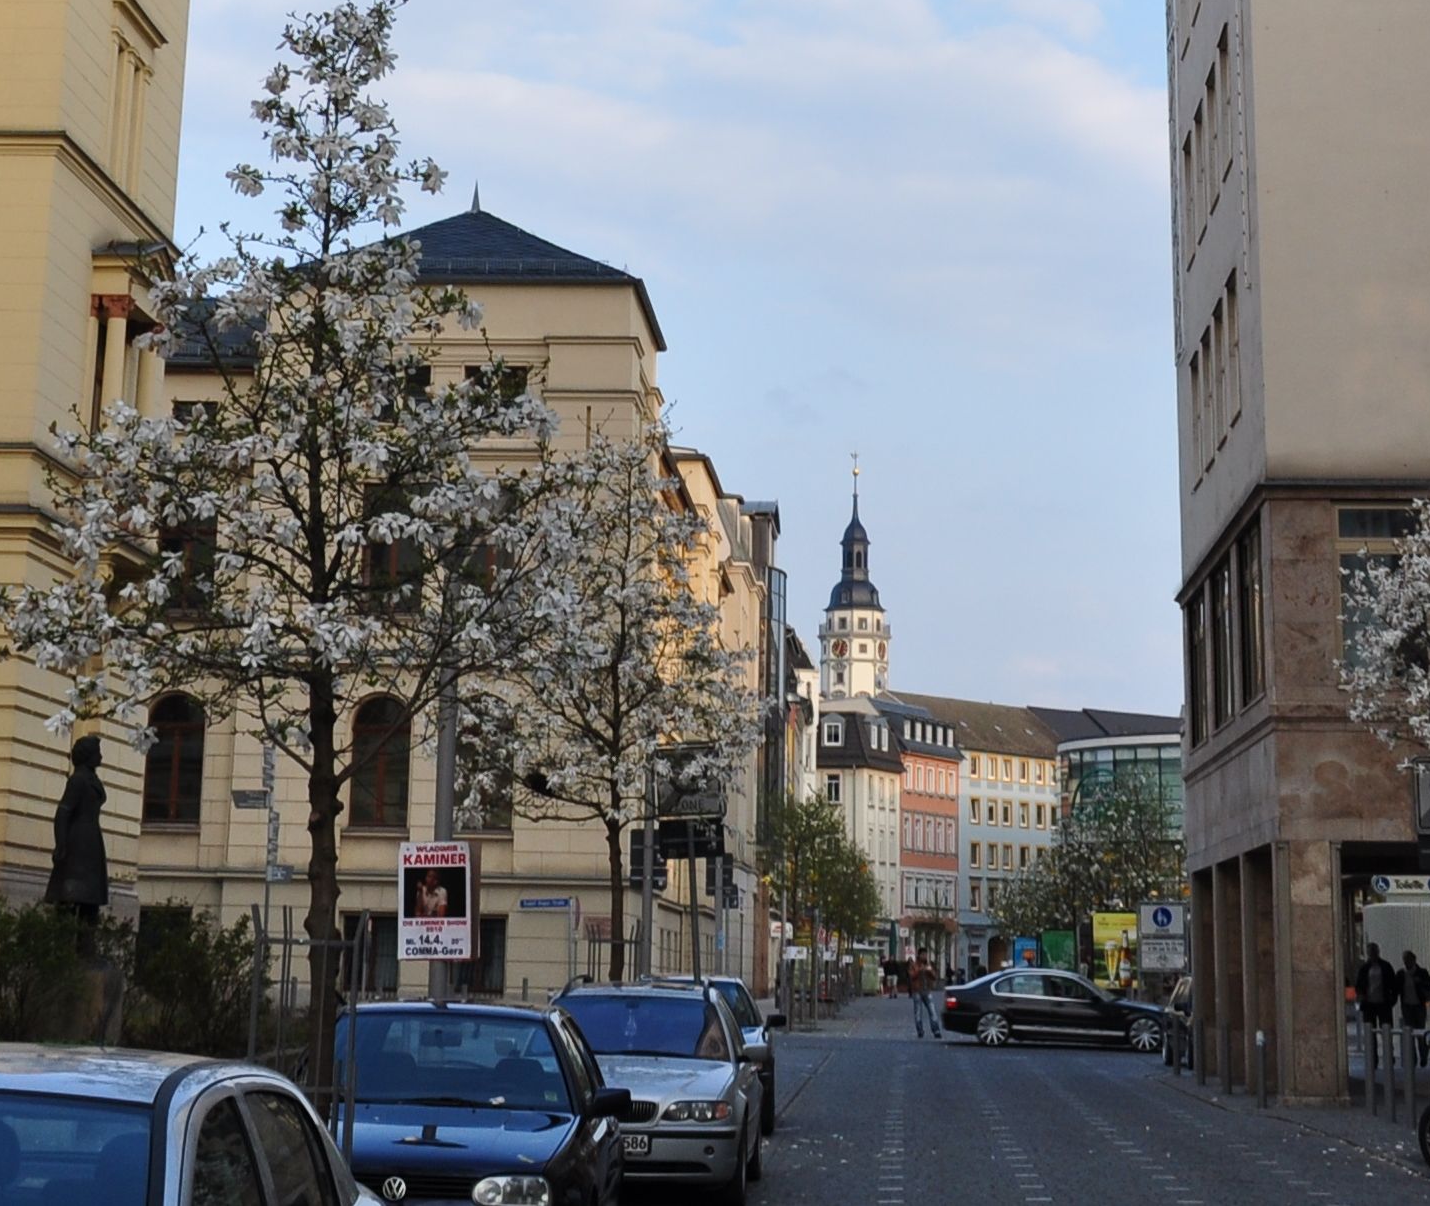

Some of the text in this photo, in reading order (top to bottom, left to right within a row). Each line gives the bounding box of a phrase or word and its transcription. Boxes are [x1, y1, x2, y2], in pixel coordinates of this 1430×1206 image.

[416, 845, 458, 853] WLADIMIR
[403, 854, 466, 865] KAMINER
[1394, 879, 1424, 890] Toilette
[405, 947, 463, 955] COMMA-Gera
[623, 1136, 646, 1149] 586
